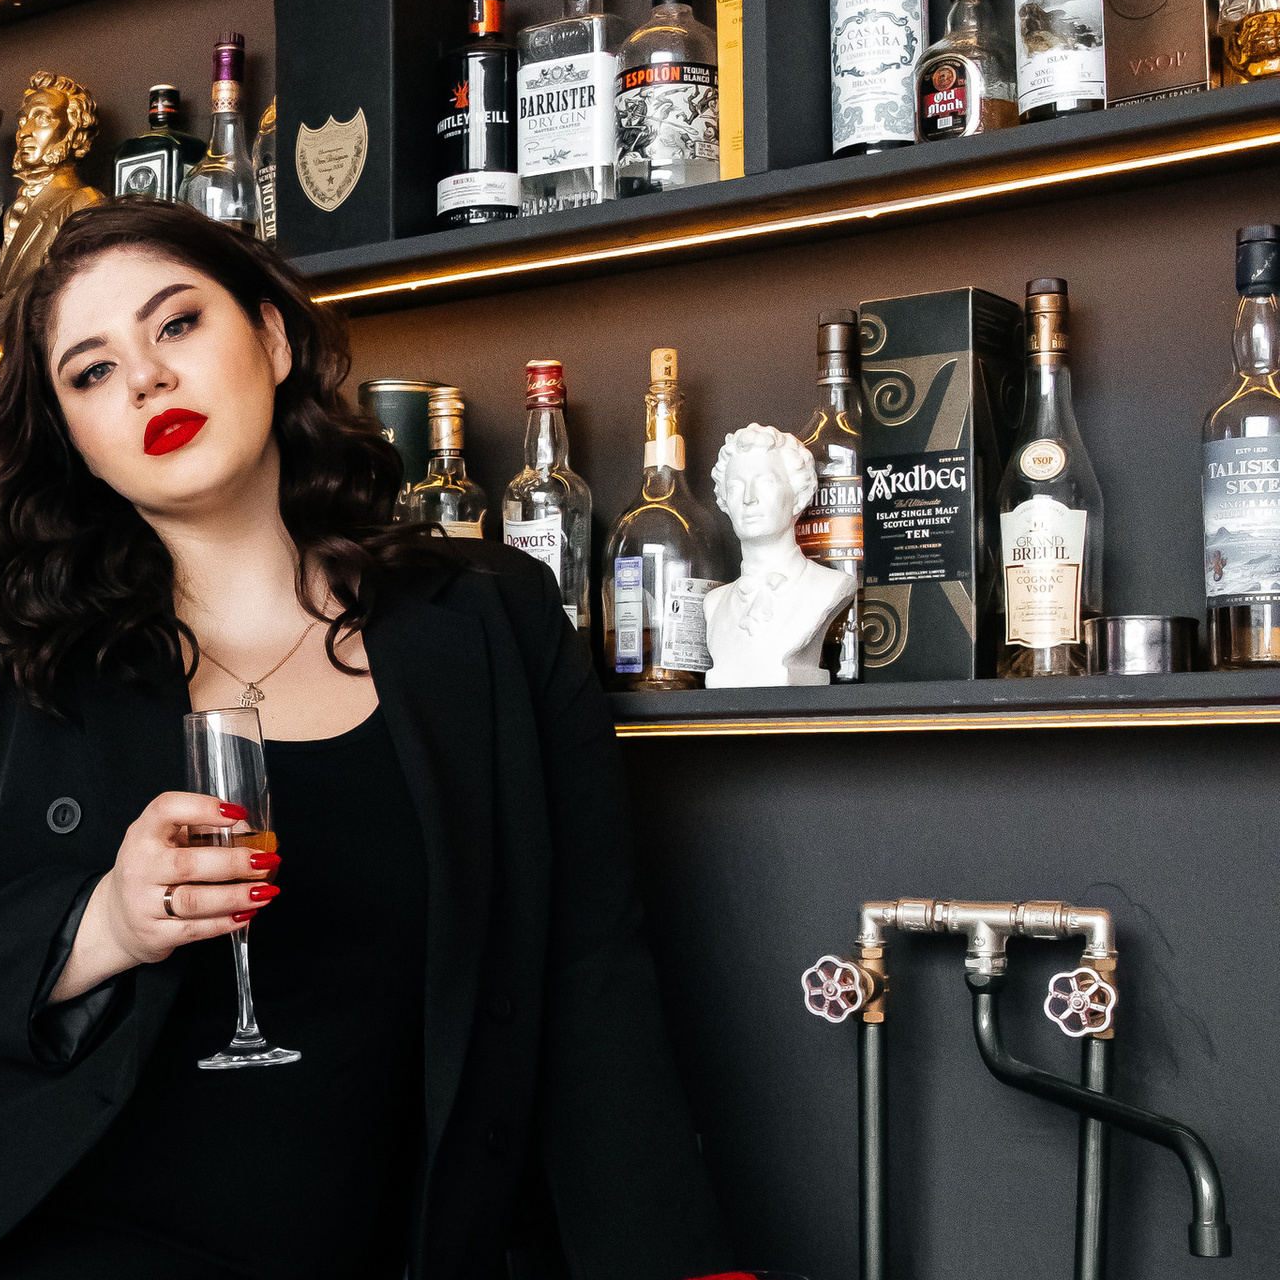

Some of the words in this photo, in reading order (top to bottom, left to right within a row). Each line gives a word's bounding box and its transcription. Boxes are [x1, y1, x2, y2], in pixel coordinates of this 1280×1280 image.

[847, 24, 890, 41] CASAL
[1046, 54, 1069, 64] ISLAY
[1128, 50, 1187, 76] VSOP
[682, 66, 710, 76] TEQUILA
[682, 74, 710, 84] BLANCO
[851, 77, 887, 88] BRANCO
[519, 84, 597, 120] BARRISTER
[933, 88, 955, 103] Old
[927, 98, 964, 118] Monk
[437, 112, 470, 135] WHITLEY
[528, 115, 556, 131] DRY
[559, 110, 587, 125] GIN
[261, 182, 277, 238] MELON
[1032, 456, 1054, 466] VSOP
[1226, 478, 1280, 495] SKYE
[908, 498, 942, 508] Ultimate
[876, 510, 900, 520] ISLAY
[901, 508, 933, 518] SINGLE
[934, 506, 959, 516] MALT
[812, 521, 830, 535] OAK
[882, 519, 915, 529] SCOTCH
[917, 516, 952, 526] WHISKY
[905, 529, 930, 539] TEN
[1015, 535, 1065, 548] GRAND
[1012, 546, 1070, 561] BREUIL
[1016, 575, 1064, 584] COGNAC
[1026, 584, 1054, 593] VSOP
